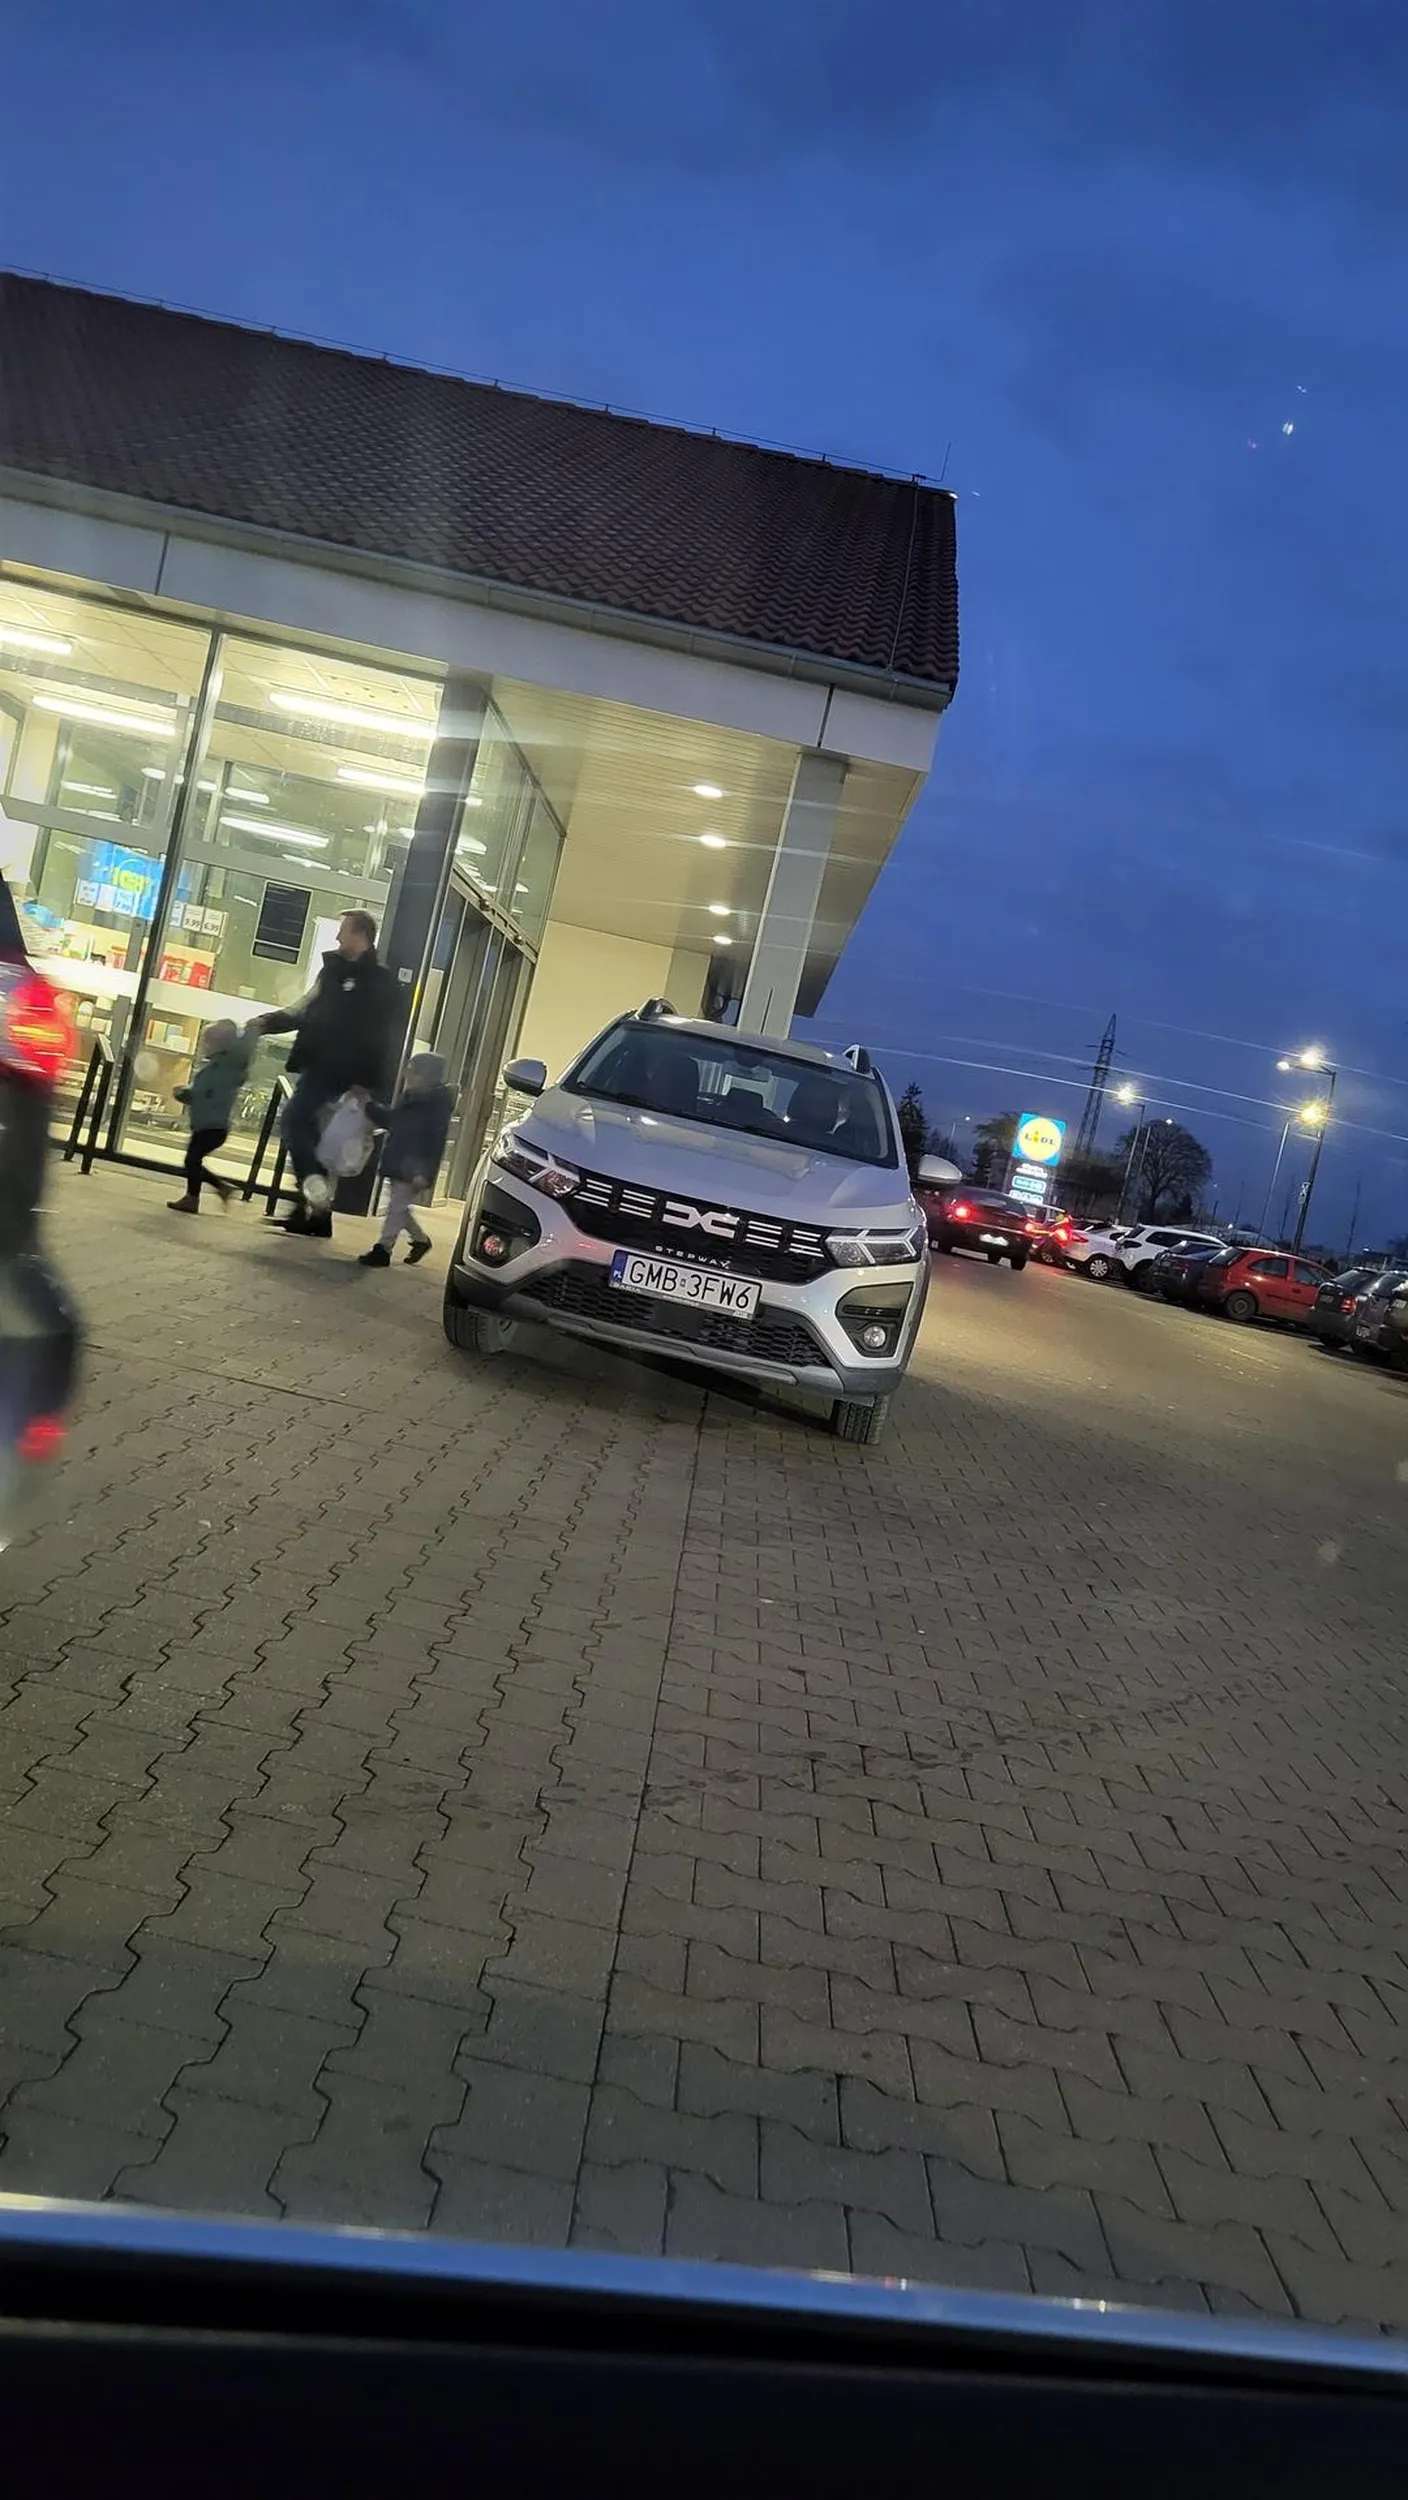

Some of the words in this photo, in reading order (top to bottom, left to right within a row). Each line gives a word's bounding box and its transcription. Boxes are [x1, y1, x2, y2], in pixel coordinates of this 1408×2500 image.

[654, 1245, 731, 1270] STEPWAY
[612, 1270, 623, 1279] PL
[629, 1260, 679, 1292] GMB
[686, 1273, 752, 1310] 3FW6
